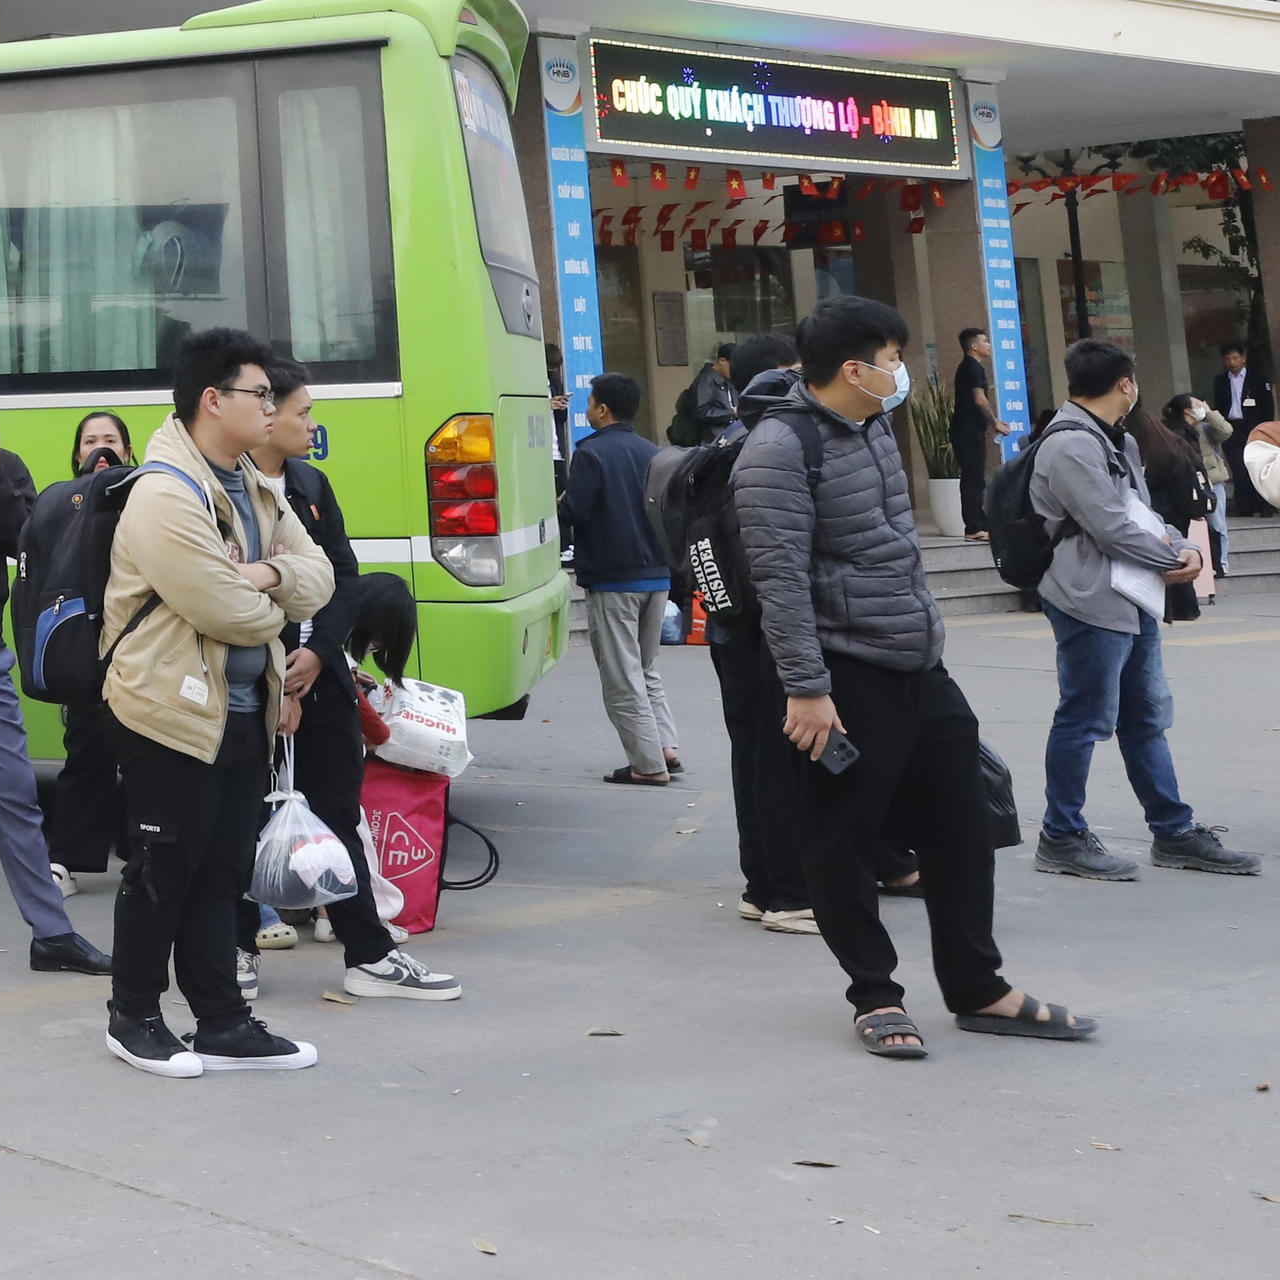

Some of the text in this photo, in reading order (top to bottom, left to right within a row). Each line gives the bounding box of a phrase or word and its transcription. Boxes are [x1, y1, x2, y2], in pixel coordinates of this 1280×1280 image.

[611, 75, 663, 115] CHÚC
[666, 81, 702, 120] QUÝ
[705, 85, 766, 125] KHÁCH
[767, 94, 836, 135] THƯỢNG
[837, 97, 860, 138] LỘ
[871, 99, 912, 138] BÌNH
[914, 108, 938, 140] AN
[697, 537, 733, 610] INSIDER
